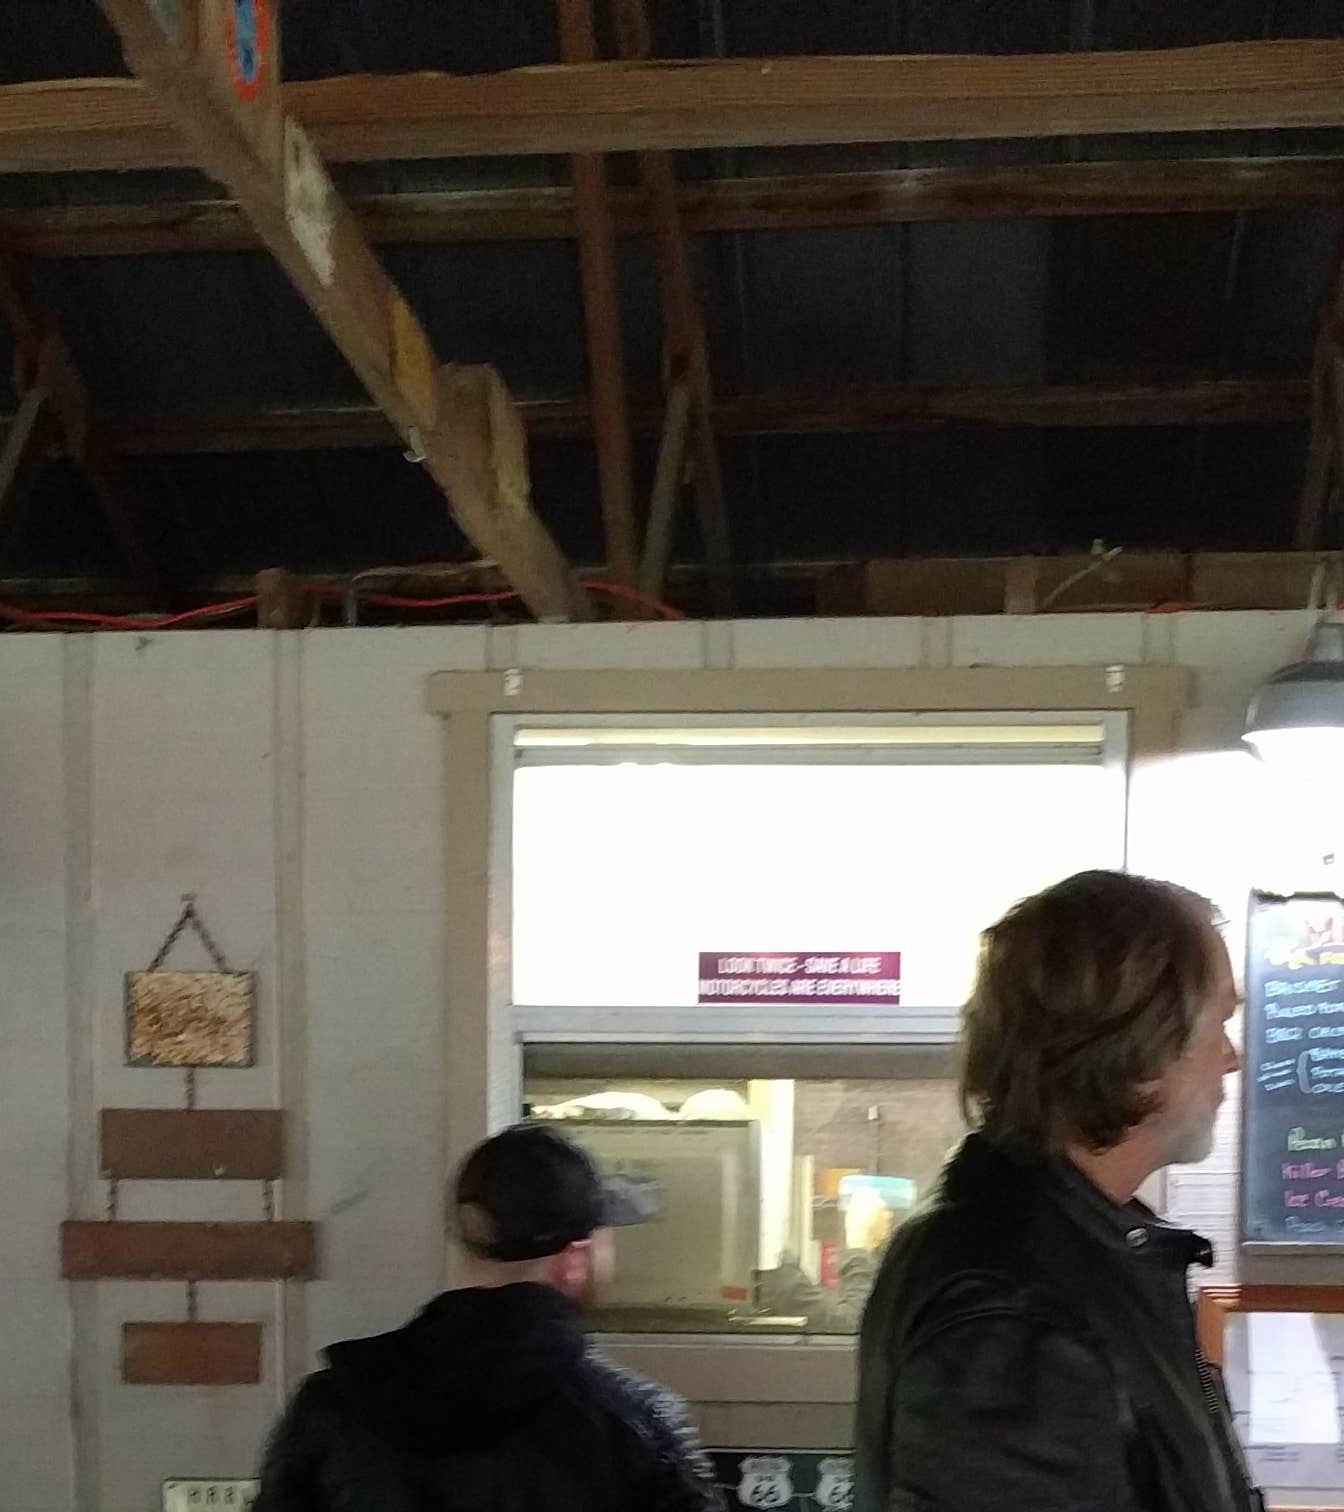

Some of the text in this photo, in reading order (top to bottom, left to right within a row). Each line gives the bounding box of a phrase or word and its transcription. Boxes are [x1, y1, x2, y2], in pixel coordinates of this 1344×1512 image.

[805, 957, 840, 974] SAVE
[789, 979, 816, 996] ARE
[816, 979, 902, 996] EVERYWHERE
[751, 1484, 780, 1503] 66
